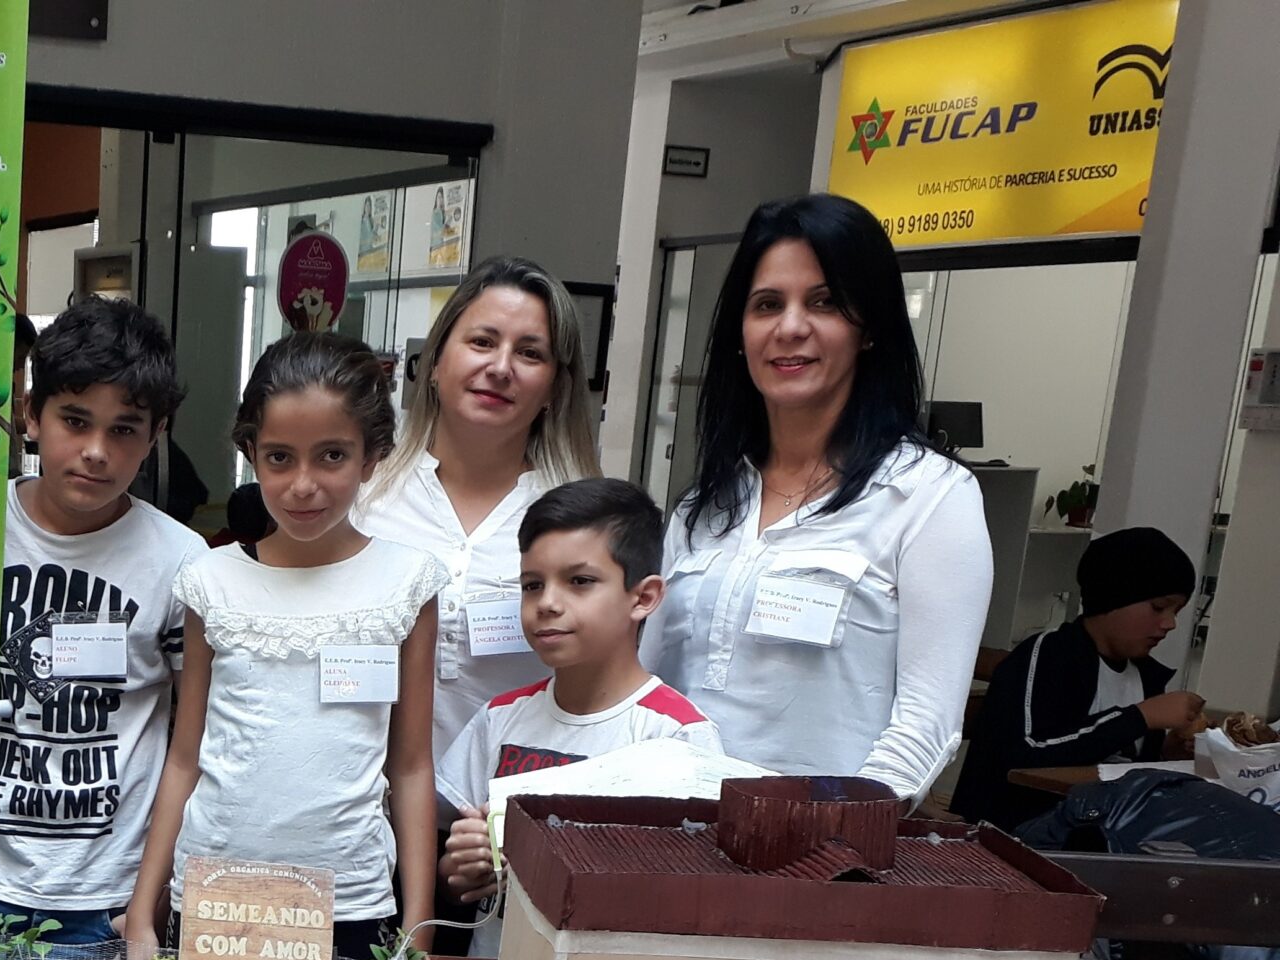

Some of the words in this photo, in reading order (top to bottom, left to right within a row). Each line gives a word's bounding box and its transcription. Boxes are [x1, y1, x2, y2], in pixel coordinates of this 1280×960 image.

[905, 96, 978, 117] FACULDADES
[896, 101, 1039, 147] FUCAP
[918, 181, 942, 196] UMA
[943, 175, 987, 193] HISTÓRIA
[989, 175, 1003, 189] DE
[1004, 170, 1055, 188] PARCERIA
[1058, 169, 1065, 183] E
[1066, 164, 1117, 183] SUCESSO
[881, 217, 894, 239] 8)
[897, 216, 905, 235] 9
[907, 212, 939, 233] 9189
[942, 209, 974, 230] 0350
[753, 611, 791, 623] CRISTIANE
[756, 600, 802, 613] PROFESSORA
[62, 745, 119, 786] OUT
[9, 784, 120, 820] RHYMES
[230, 863, 270, 875] ORGÂNICA
[197, 900, 326, 928] SEMEANDO
[195, 934, 248, 956] COM
